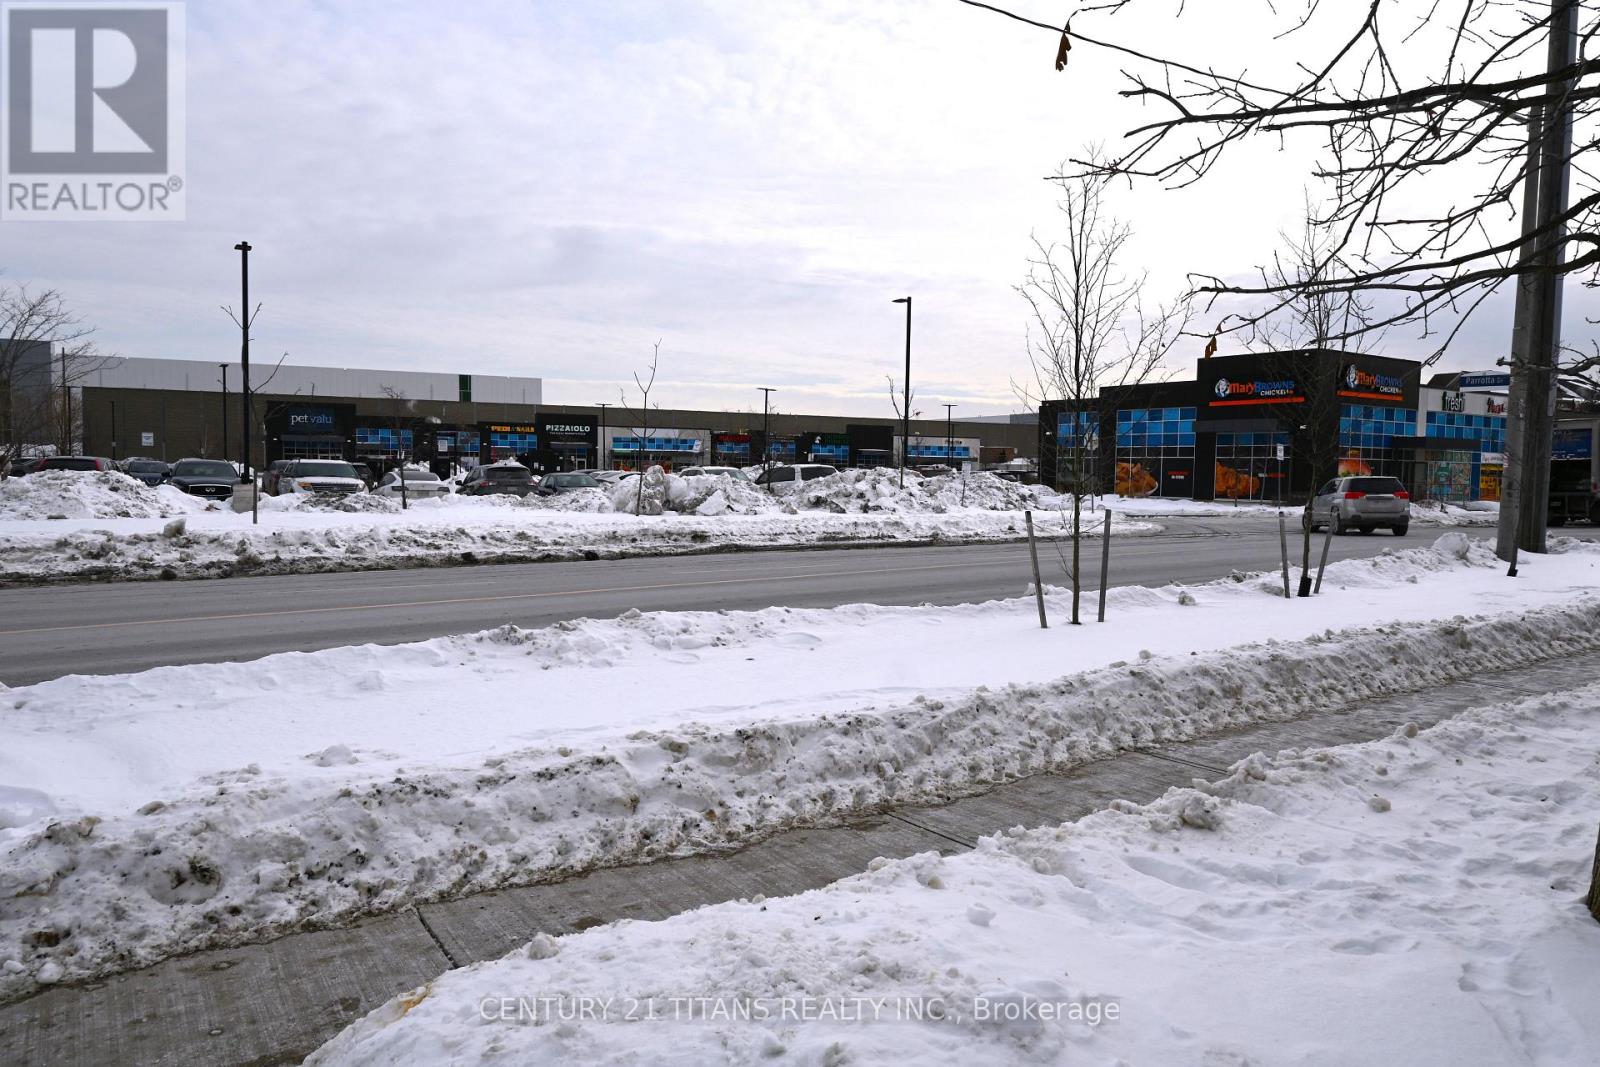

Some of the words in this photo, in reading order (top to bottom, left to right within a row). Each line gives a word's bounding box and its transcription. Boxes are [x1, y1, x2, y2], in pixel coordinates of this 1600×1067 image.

[290, 414, 309, 425] pet
[310, 414, 333, 424] valu
[545, 424, 591, 432] PIZZAIOLO
